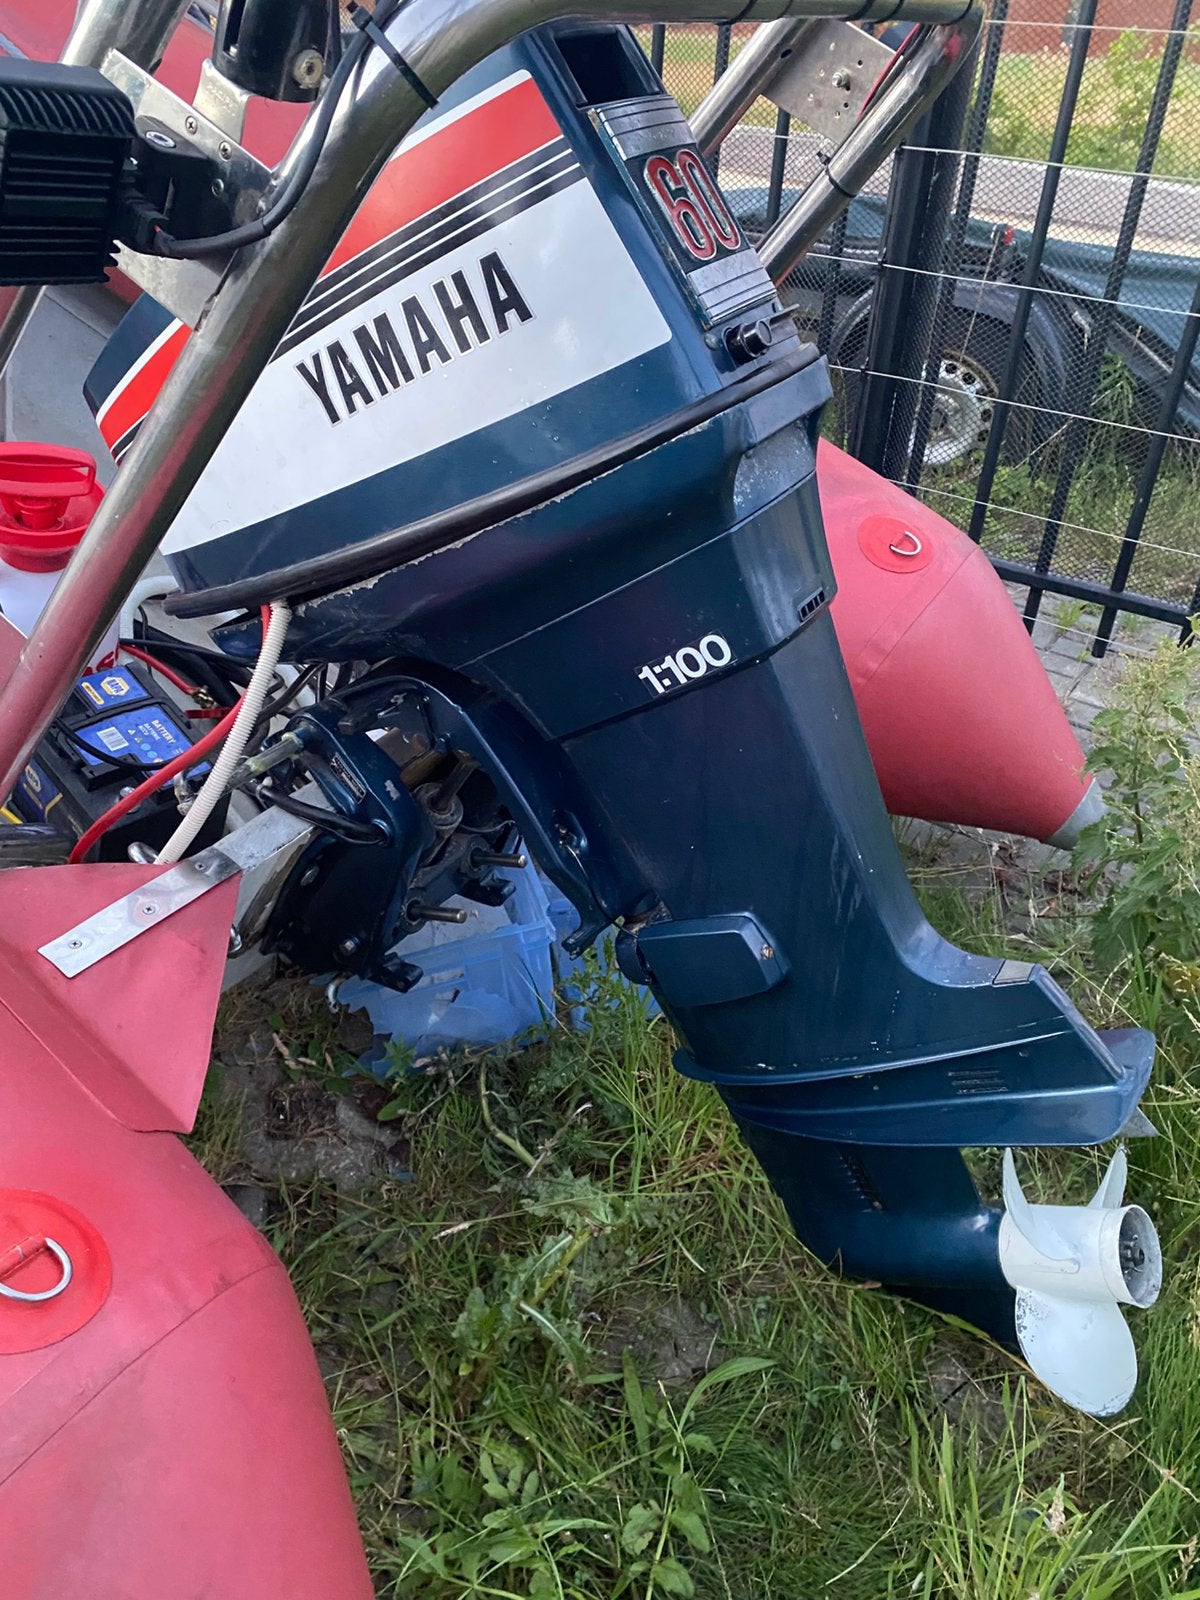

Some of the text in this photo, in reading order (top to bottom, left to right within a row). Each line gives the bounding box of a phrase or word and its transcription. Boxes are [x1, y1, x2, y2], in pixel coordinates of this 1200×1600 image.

[644, 149, 741, 260] 60
[296, 251, 533, 424] YAMAHA
[638, 634, 732, 694] 1:100
[151, 719, 176, 743] BATTERY
